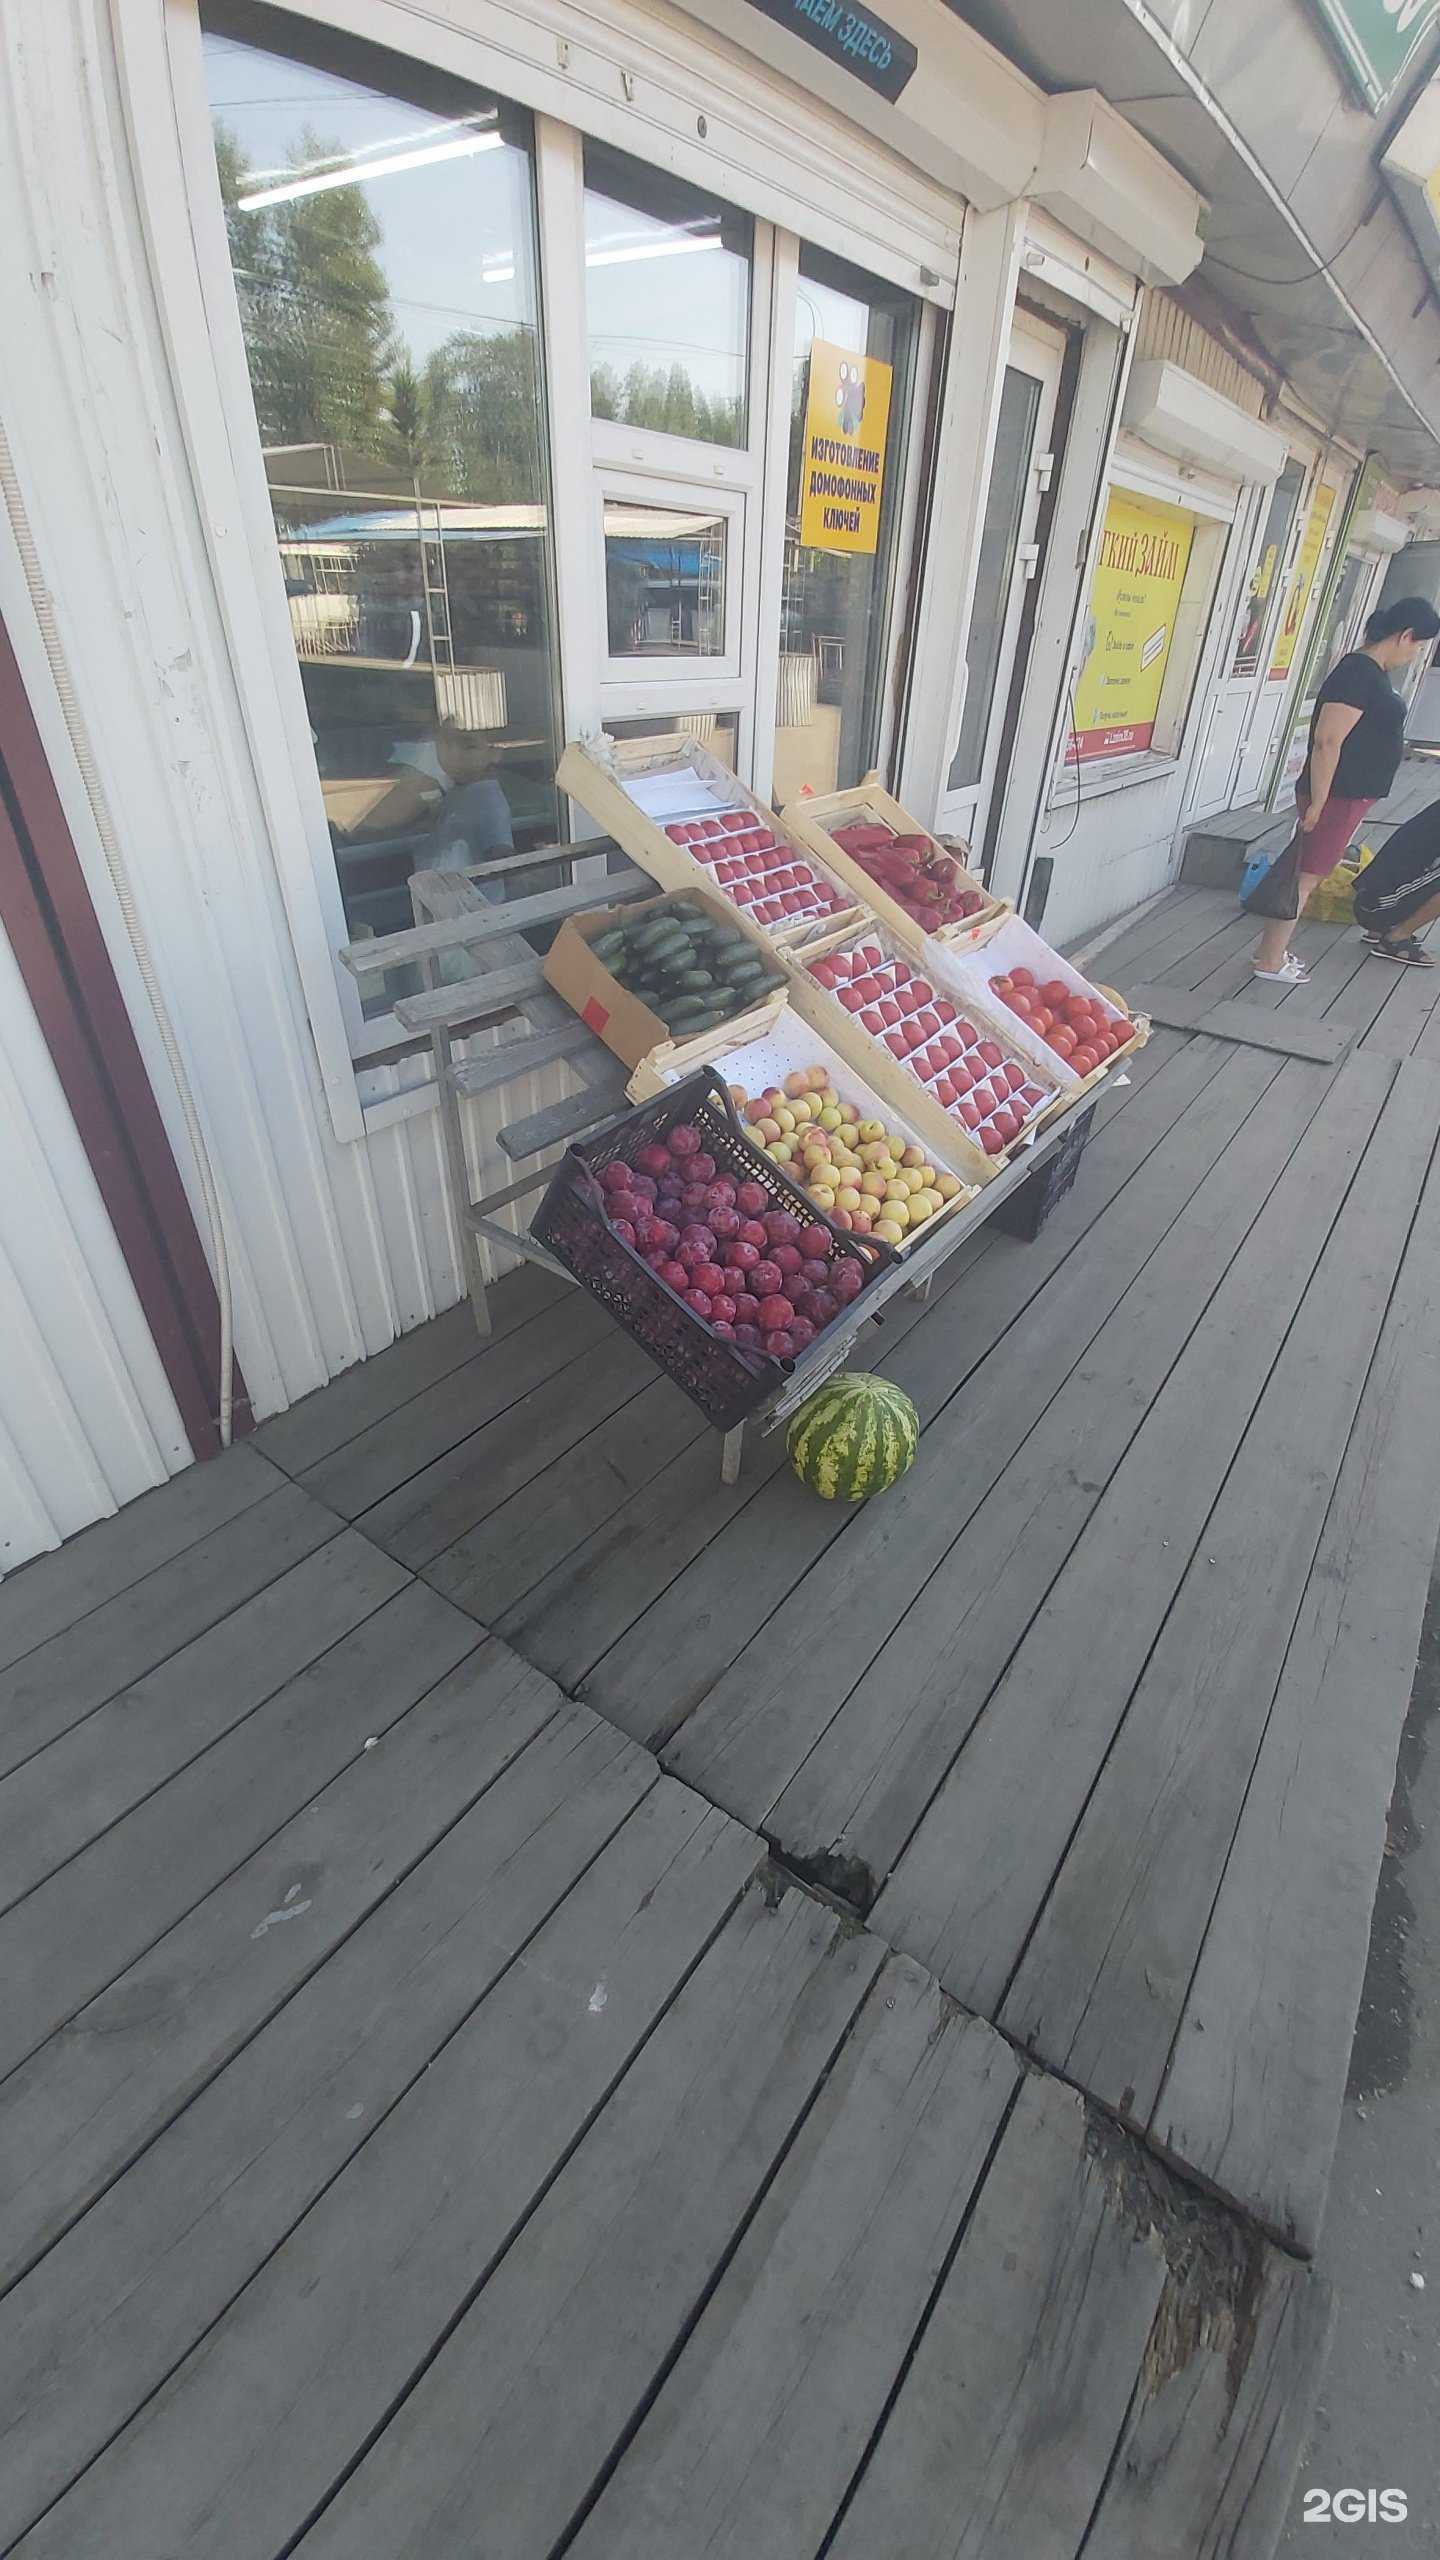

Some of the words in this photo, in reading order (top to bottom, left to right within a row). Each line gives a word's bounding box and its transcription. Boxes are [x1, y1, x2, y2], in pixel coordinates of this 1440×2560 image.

[837, 13, 892, 70] ЗДЕСЬ
[811, 435, 880, 473] ИЗГОТОВЛЕНИЕ
[809, 470, 877, 504] ДОМОФОННЫХ
[823, 505, 861, 533] КЛЮЧЕЙ
[1134, 527, 1179, 580] ЗАЙМ
